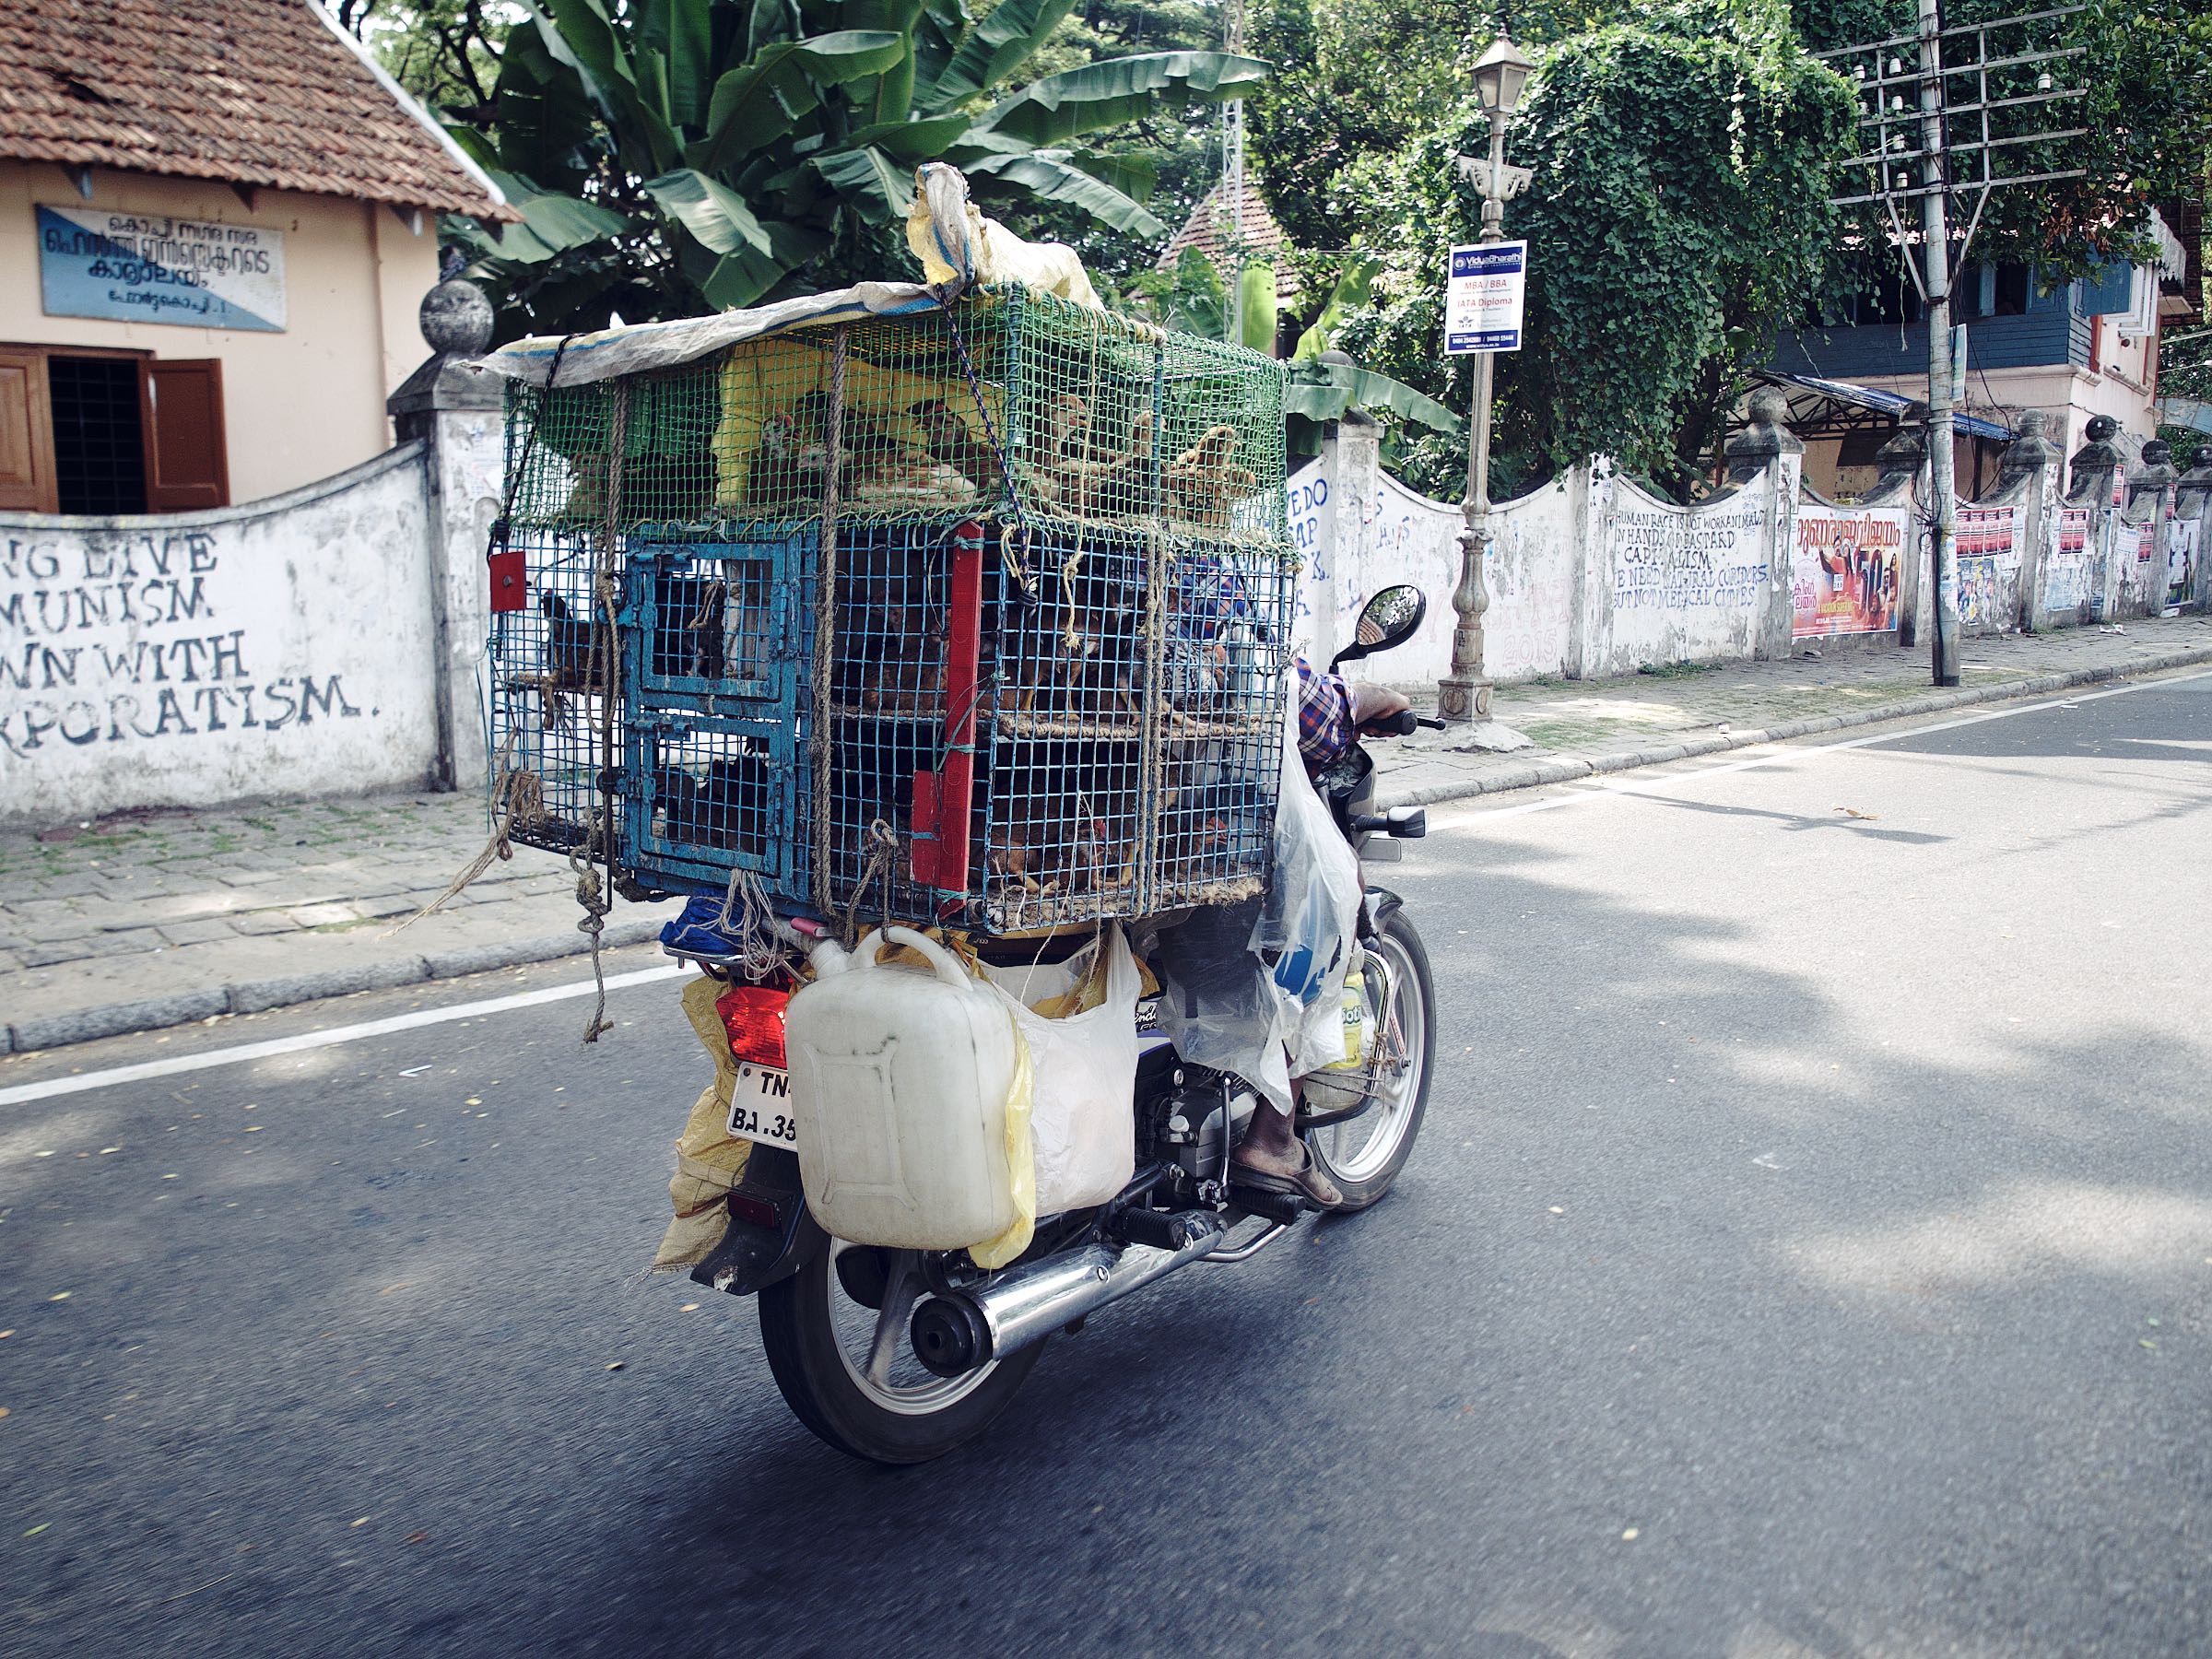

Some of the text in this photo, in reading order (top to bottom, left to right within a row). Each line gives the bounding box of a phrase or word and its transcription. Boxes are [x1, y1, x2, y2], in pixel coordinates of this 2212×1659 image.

[1465, 281, 1483, 290] MBA
[1490, 279, 1507, 288] BBA
[1457, 297, 1512, 308] IATA Diploma
[1651, 512, 1674, 529] RACE
[1627, 528, 1665, 547] HANDS
[80, 533, 218, 580] LIVE
[1629, 566, 1660, 587] NEED
[91, 629, 250, 683] WITH
[760, 1071, 791, 1098] TN
